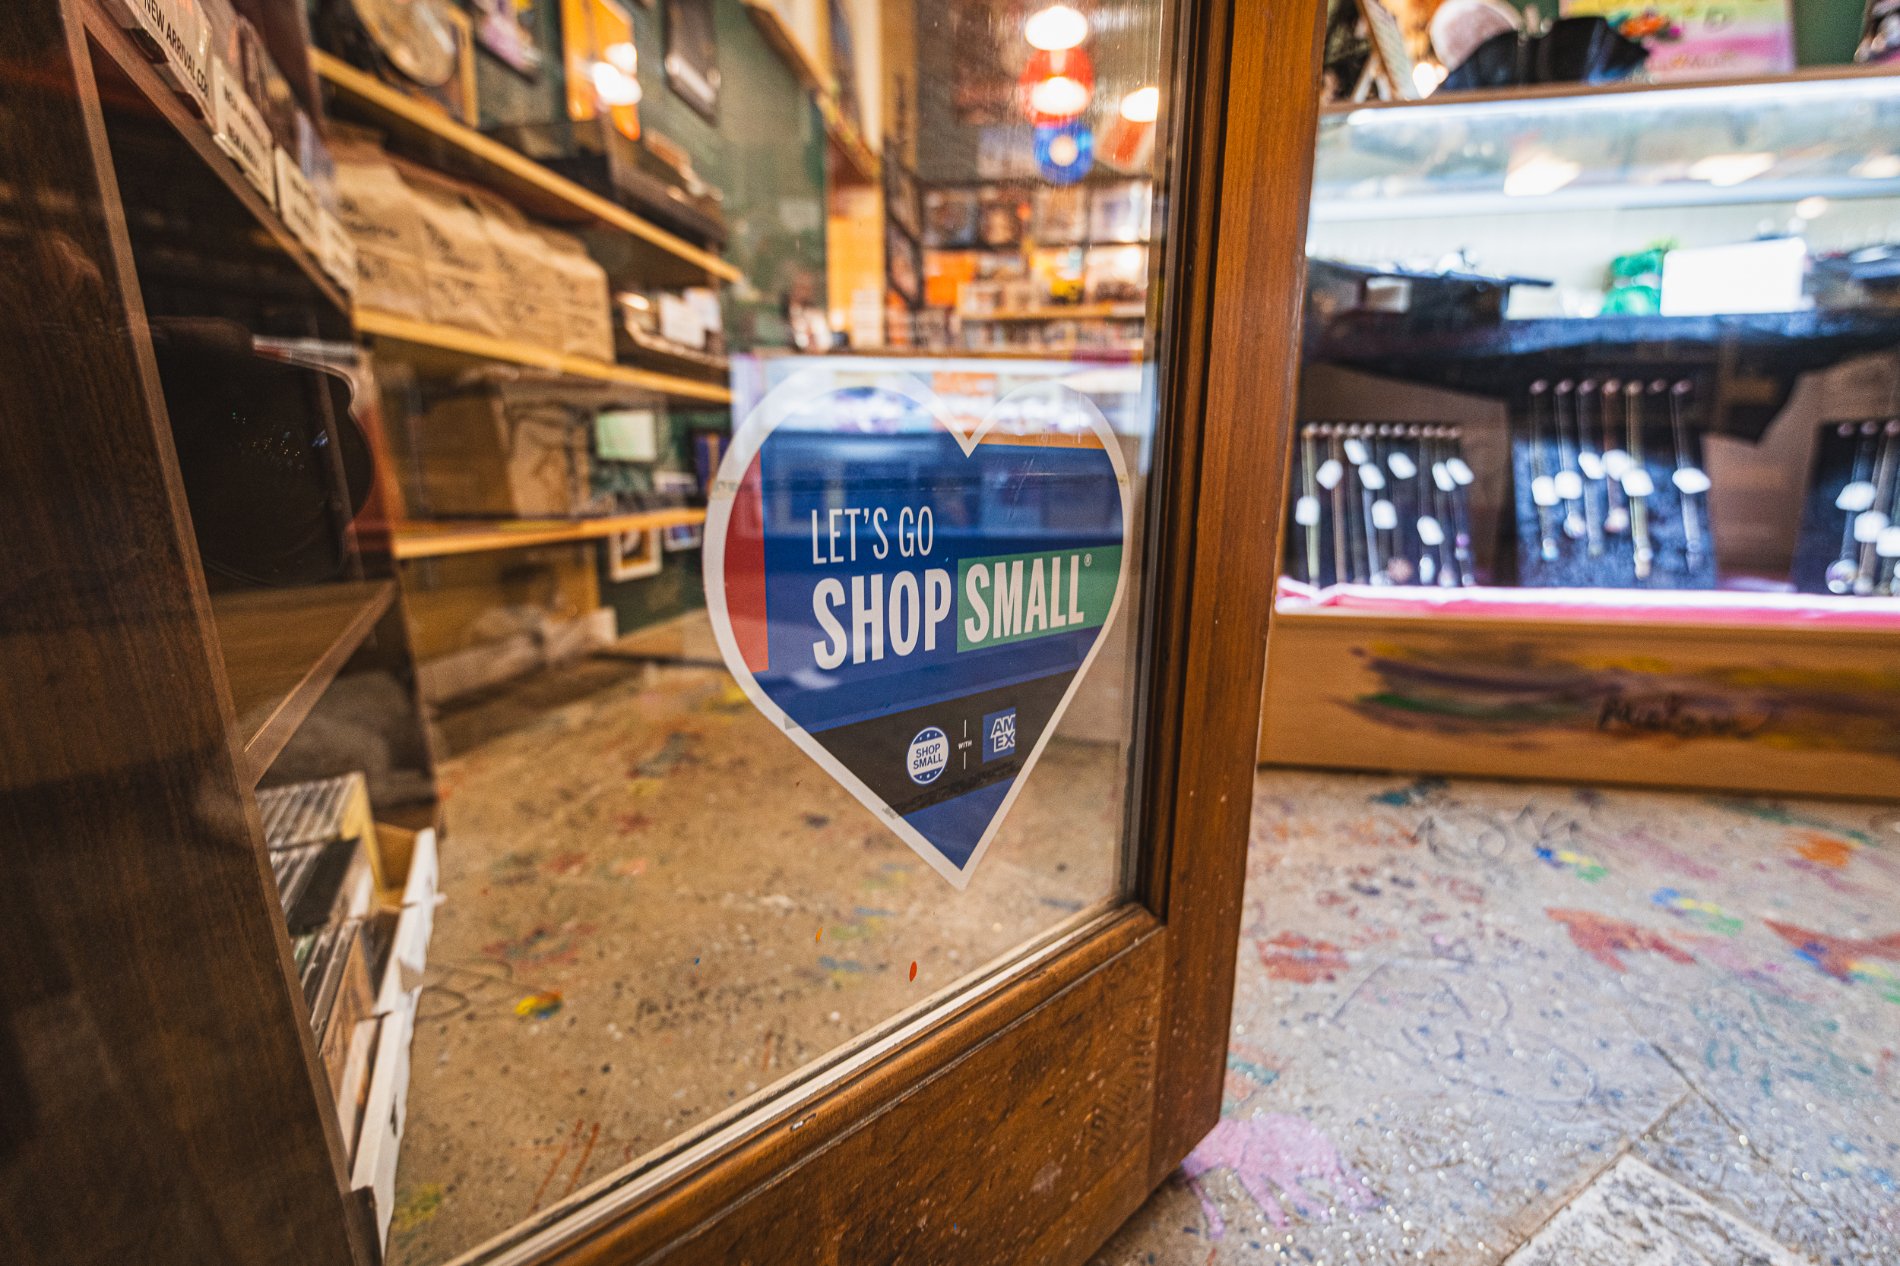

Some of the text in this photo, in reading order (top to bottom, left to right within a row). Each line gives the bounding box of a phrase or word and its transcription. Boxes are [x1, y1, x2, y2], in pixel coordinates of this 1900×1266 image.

[144, 0, 165, 32] NEW
[166, 22, 196, 80] ARRIVAL
[811, 505, 934, 565] LET'S GO
[812, 567, 951, 670] SHOP
[913, 753, 943, 770] SMALL
[916, 743, 941, 759] SHOP
[958, 740, 973, 750] WITH
